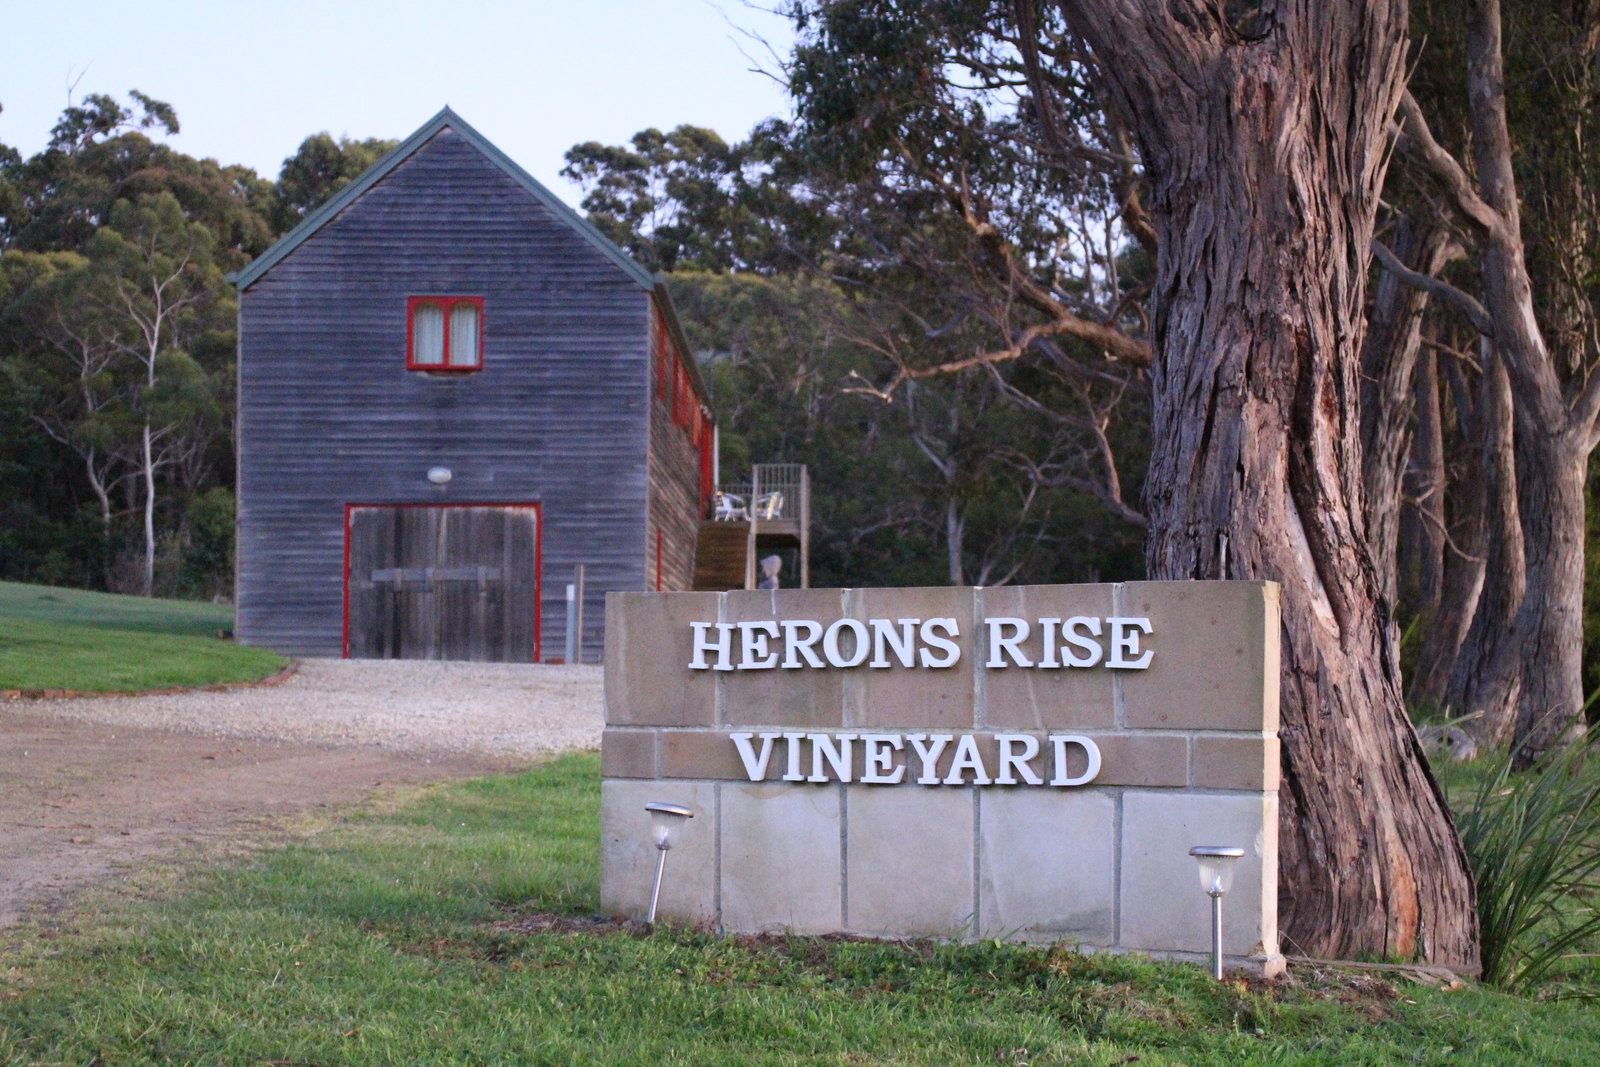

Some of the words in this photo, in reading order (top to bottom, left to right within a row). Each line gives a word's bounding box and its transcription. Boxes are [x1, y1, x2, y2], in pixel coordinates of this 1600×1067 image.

[687, 617, 961, 671] HERONS
[985, 616, 1155, 670] RISE
[729, 732, 1102, 787] VINEYARD
